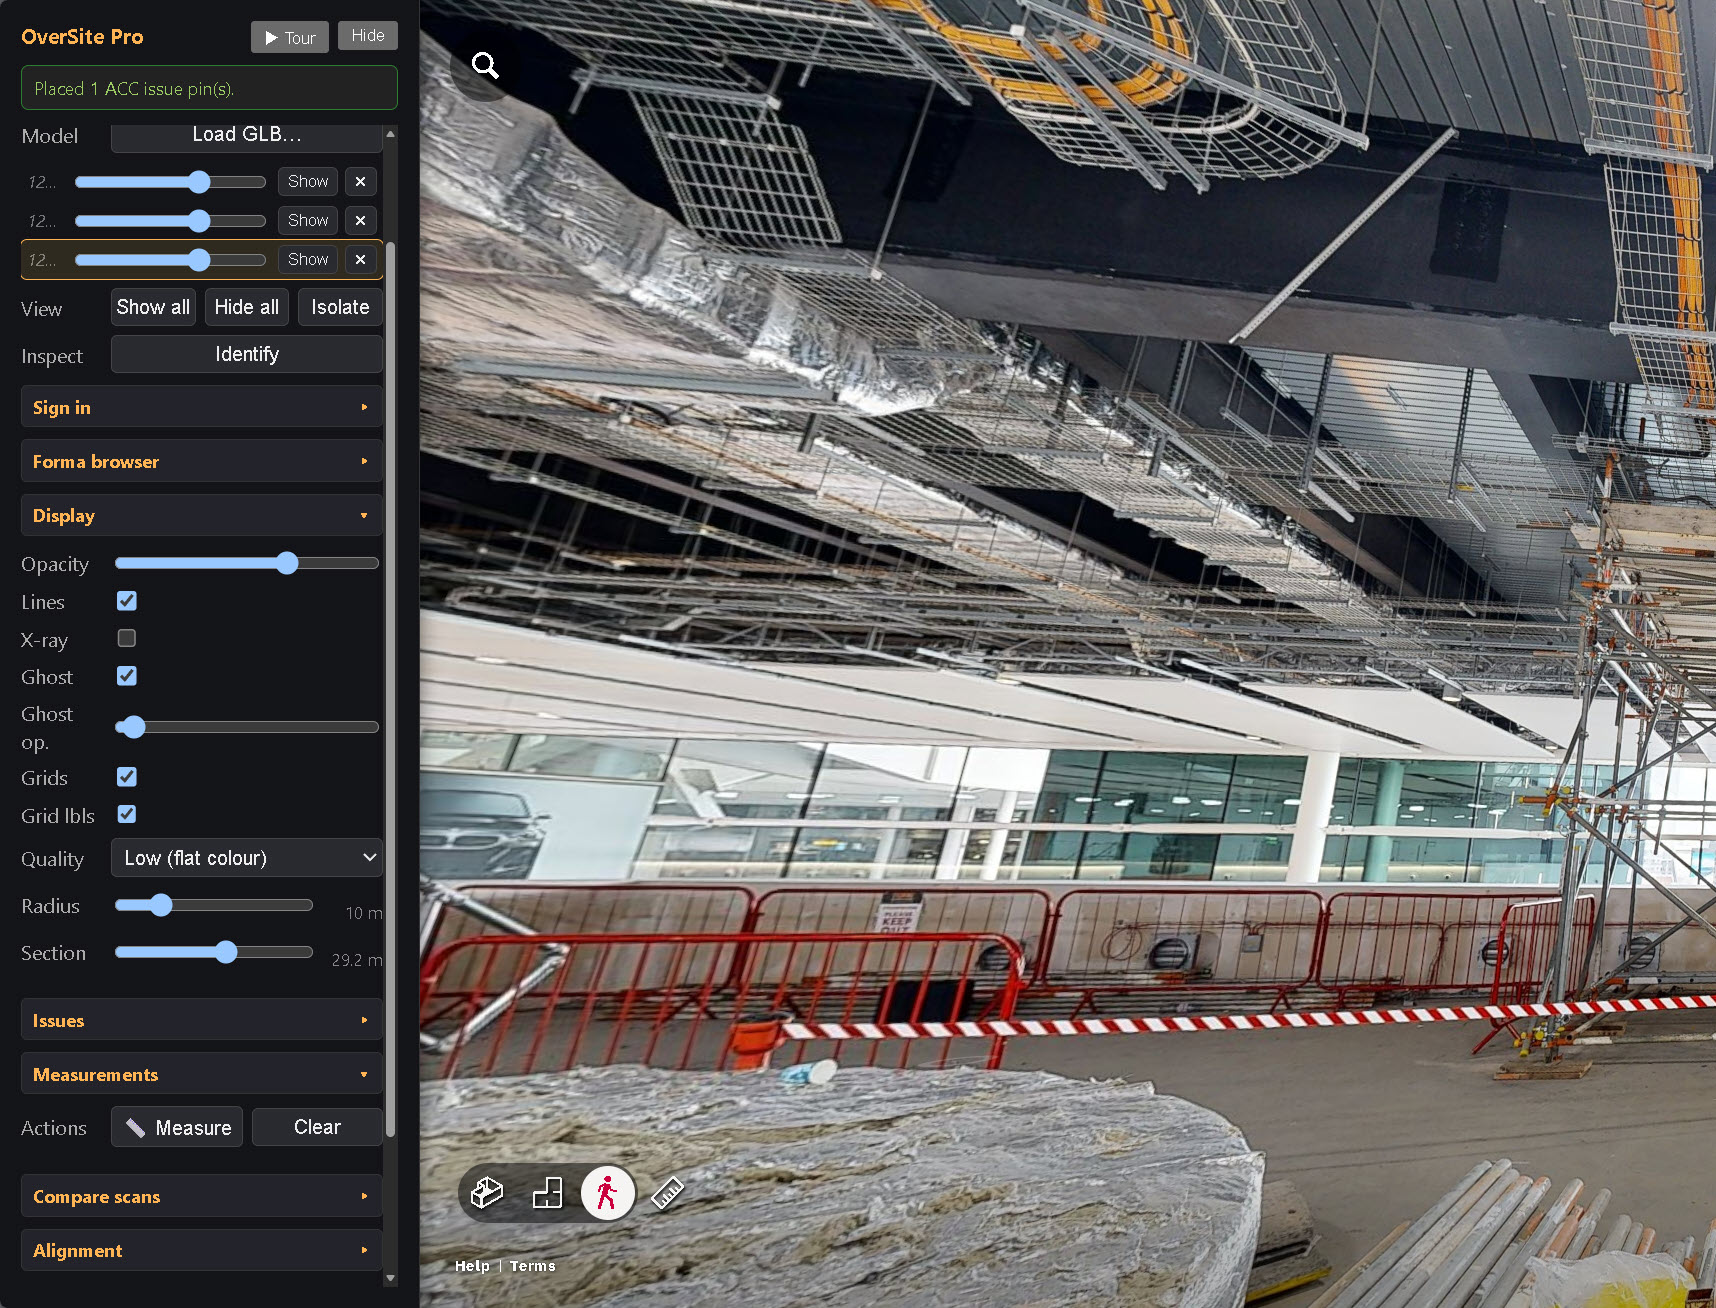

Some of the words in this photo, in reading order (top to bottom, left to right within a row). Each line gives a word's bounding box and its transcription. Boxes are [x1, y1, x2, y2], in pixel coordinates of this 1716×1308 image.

[21, 27, 105, 45] OverSite
[111, 28, 144, 45] Pro
[284, 31, 317, 45] Tour
[352, 28, 385, 42] Hide
[35, 80, 84, 96] Placed
[91, 81, 97, 96] 1
[104, 81, 139, 96] ACC
[144, 81, 183, 96] issue
[188, 81, 234, 100] pin(s).
[22, 127, 78, 144] Model
[193, 125, 236, 142] Load
[288, 174, 329, 188] Show
[288, 213, 329, 227] Show
[288, 252, 329, 266] Show
[20, 300, 63, 317] View
[116, 298, 166, 315] Show
[171, 298, 190, 315] all
[215, 298, 254, 315] Hide
[260, 298, 279, 315] all
[312, 298, 370, 315] Isolate
[22, 348, 84, 369] Inspect
[216, 345, 280, 366] Identify
[33, 399, 70, 419] Sign
[75, 399, 91, 415] in
[33, 454, 86, 469] Forma
[91, 453, 160, 469] browser
[33, 507, 96, 527] Display
[21, 555, 90, 577] Opacity
[22, 593, 65, 610] Lines
[20, 632, 69, 653] X-ray
[21, 668, 74, 685] Ghost
[21, 705, 74, 722] Ghost
[21, 738, 49, 755] op.
[21, 769, 68, 786] Grids
[21, 807, 59, 824] Grid
[65, 807, 95, 824] lbls
[21, 850, 85, 872] Quality
[125, 849, 162, 866] Low
[167, 849, 201, 870] (flat
[207, 849, 267, 870] colour)
[22, 897, 80, 914] Radius
[346, 906, 363, 920] 10
[368, 909, 383, 920] m
[882, 918, 912, 926] KEEP
[21, 944, 86, 961] Section
[332, 953, 362, 967] 29.2
[368, 956, 383, 967] m
[33, 1013, 85, 1028] Issues
[33, 1067, 159, 1082] Measurements
[20, 1119, 87, 1136] Actions
[156, 1119, 232, 1136] Measure
[294, 1118, 342, 1135] Clear
[33, 1189, 110, 1208] Compare
[114, 1193, 161, 1204] scans
[32, 1242, 123, 1262] Alignment
